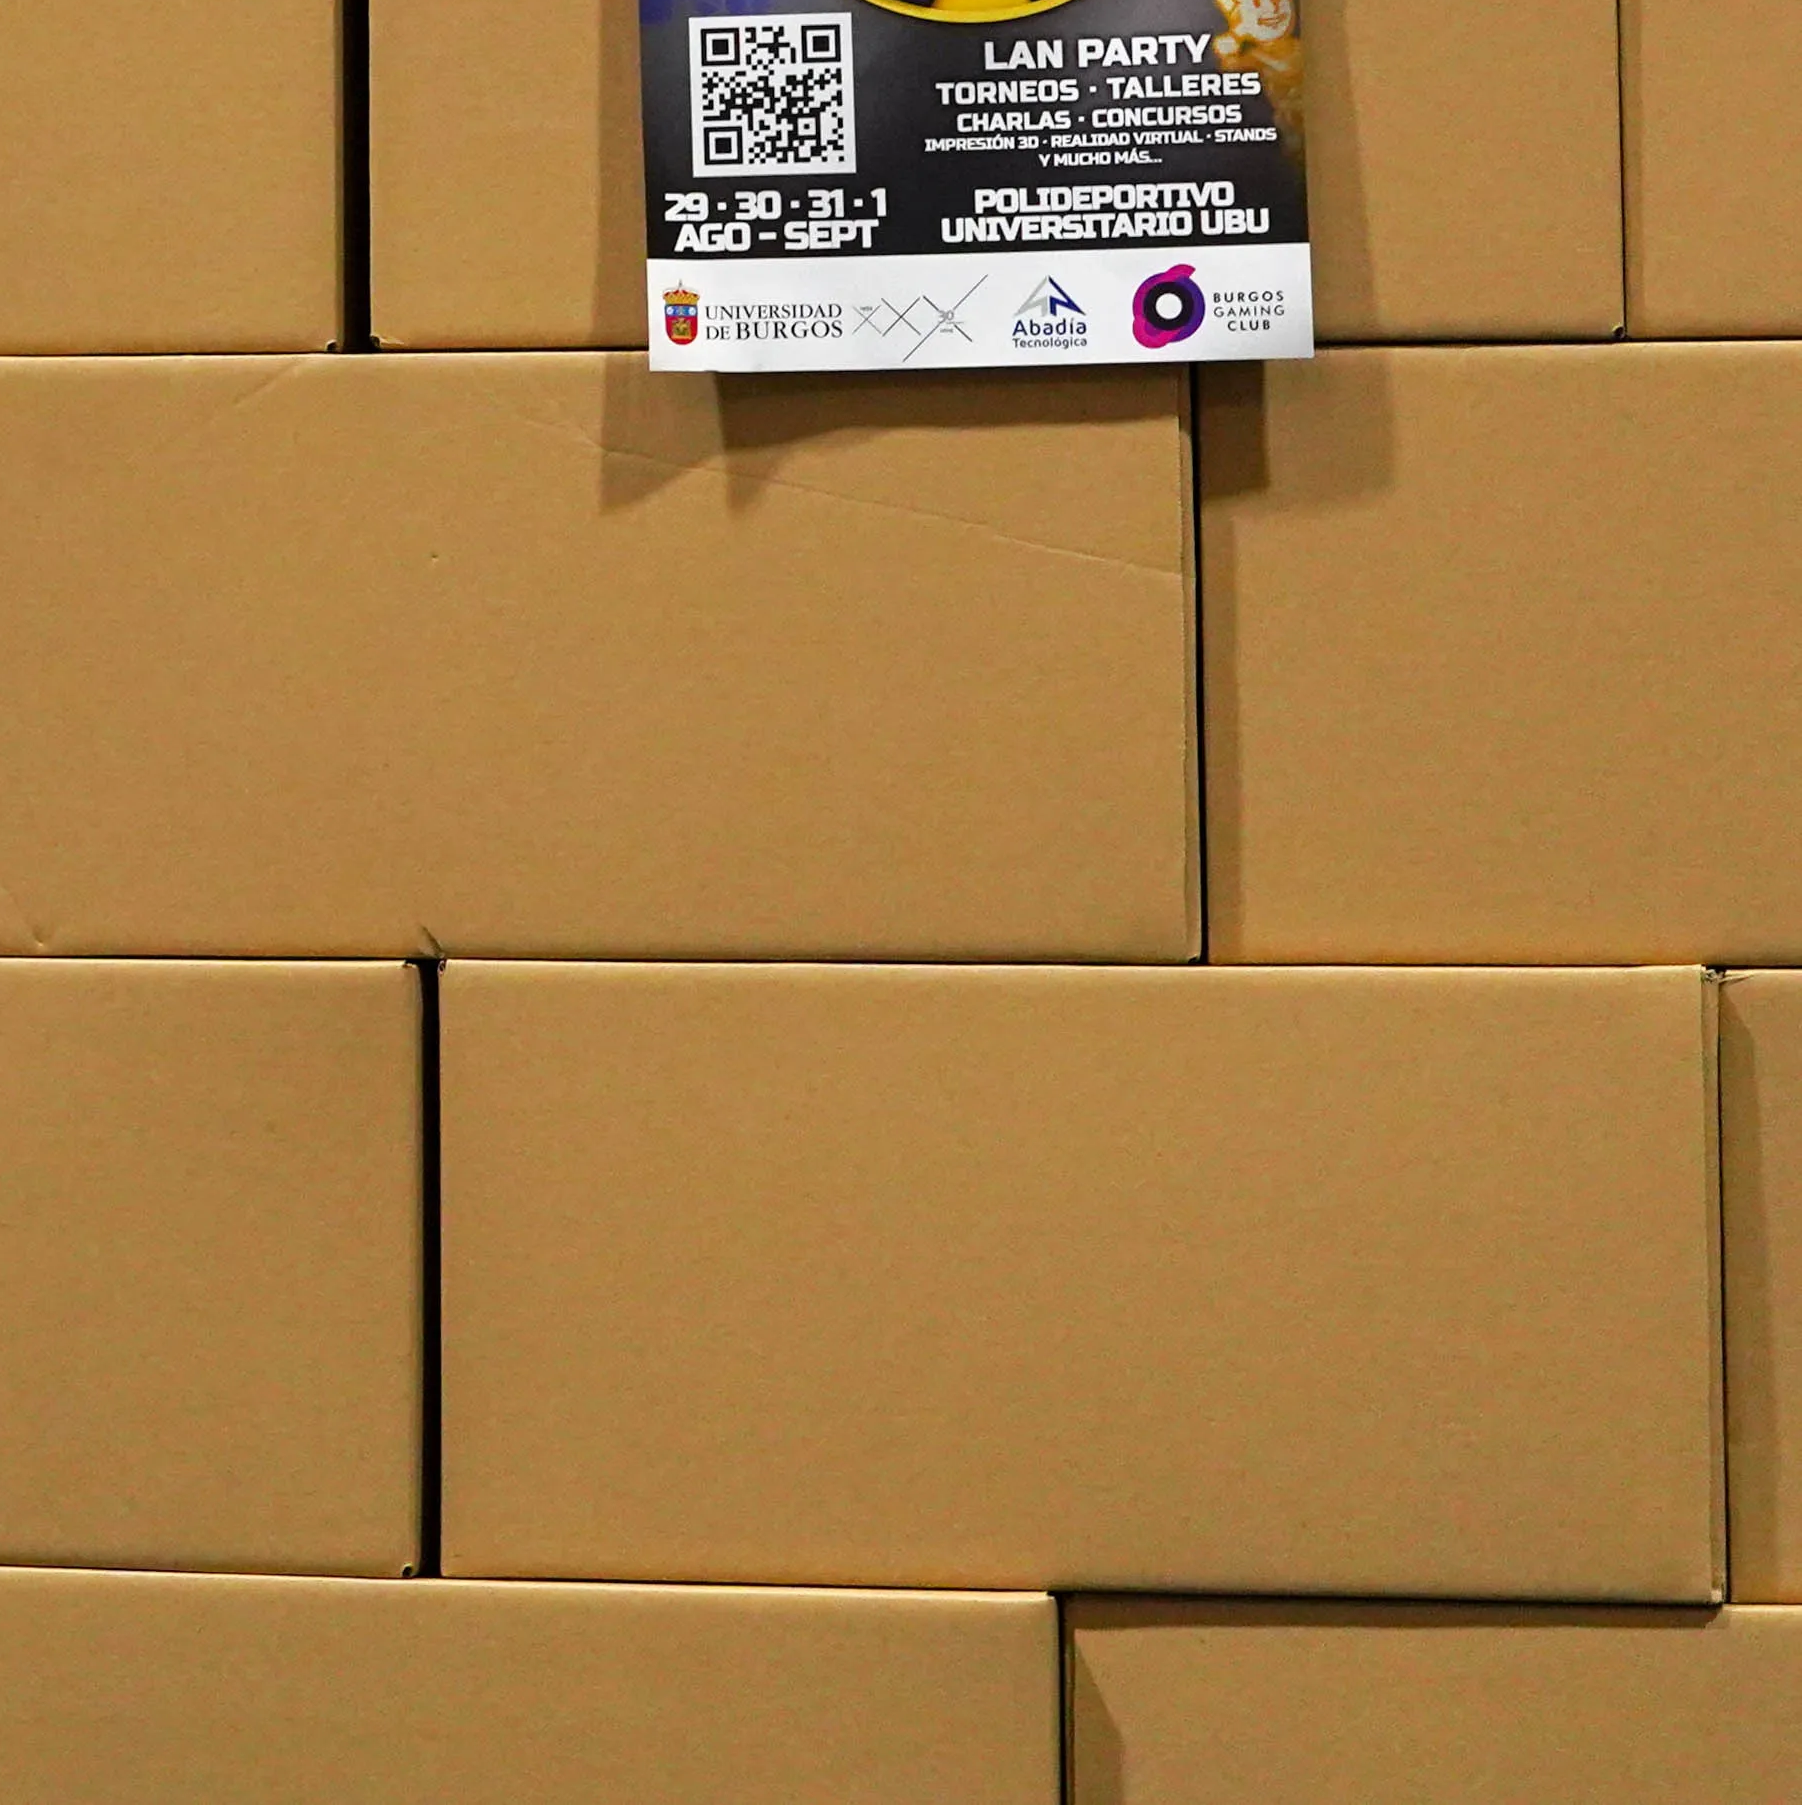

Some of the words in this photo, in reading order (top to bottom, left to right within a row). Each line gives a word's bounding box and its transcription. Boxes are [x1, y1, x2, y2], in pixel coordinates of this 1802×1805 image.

[984, 40, 1063, 71] LAN
[1078, 34, 1211, 68] PARTY
[935, 79, 1079, 105] TORNEOS
[1106, 72, 1262, 99] TALLERES
[956, 110, 1071, 133] CHARLAS
[1091, 104, 1243, 128] CONCURSOS
[924, 133, 1014, 152] IMPRESIÓN
[1017, 136, 1039, 149] 3D
[1050, 132, 1131, 148] REALIDAD
[1133, 130, 1203, 145] VIRTUAL
[1214, 127, 1277, 142] STANDS
[1039, 154, 1051, 167] Y
[1053, 152, 1110, 166] MUCHO
[1114, 148, 1162, 165] MÁS...
[664, 192, 709, 222] 29
[734, 190, 782, 220] 30
[807, 188, 845, 219] 31
[870, 188, 887, 217] 1
[974, 180, 1235, 214] POLIDEPORTIVO
[674, 222, 751, 252] AGO
[784, 219, 880, 251] SEPT
[941, 210, 1192, 243] UNIVERSITARIO
[1201, 207, 1270, 235] UBU
[1213, 291, 1284, 303] BURGOS
[705, 303, 843, 321] UNIVERSIDAD
[1213, 305, 1285, 317] GAMING
[706, 325, 731, 341] DE
[736, 320, 844, 341] BURGOS
[1012, 318, 1087, 337] Abadía
[1227, 319, 1271, 332] CLUB
[1012, 337, 1088, 350] Tecnológica
